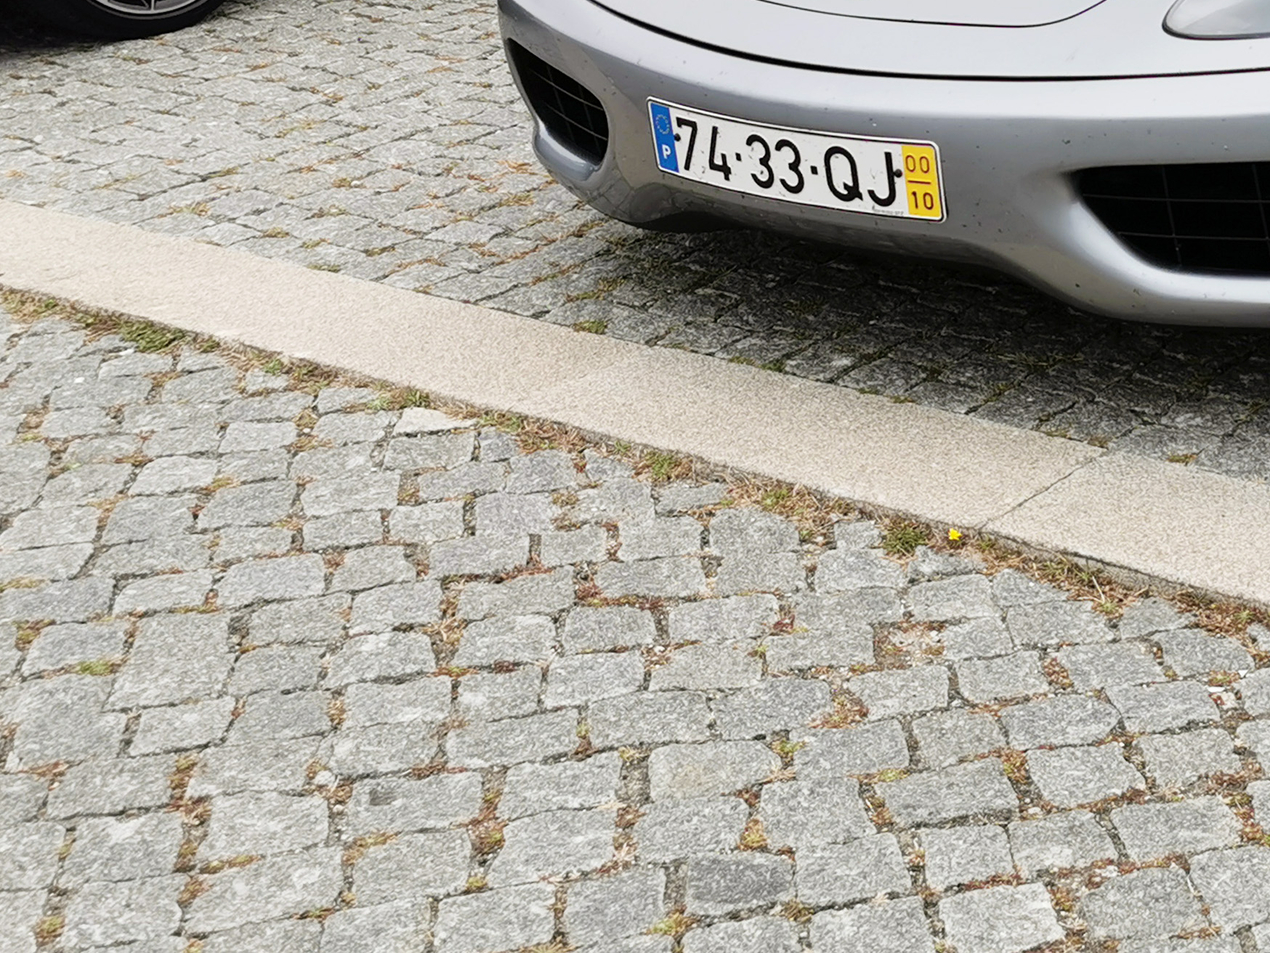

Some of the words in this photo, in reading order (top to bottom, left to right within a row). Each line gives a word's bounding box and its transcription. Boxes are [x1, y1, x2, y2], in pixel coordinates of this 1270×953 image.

[662, 144, 672, 159] P
[905, 155, 930, 173] 00
[911, 191, 934, 210] 10
